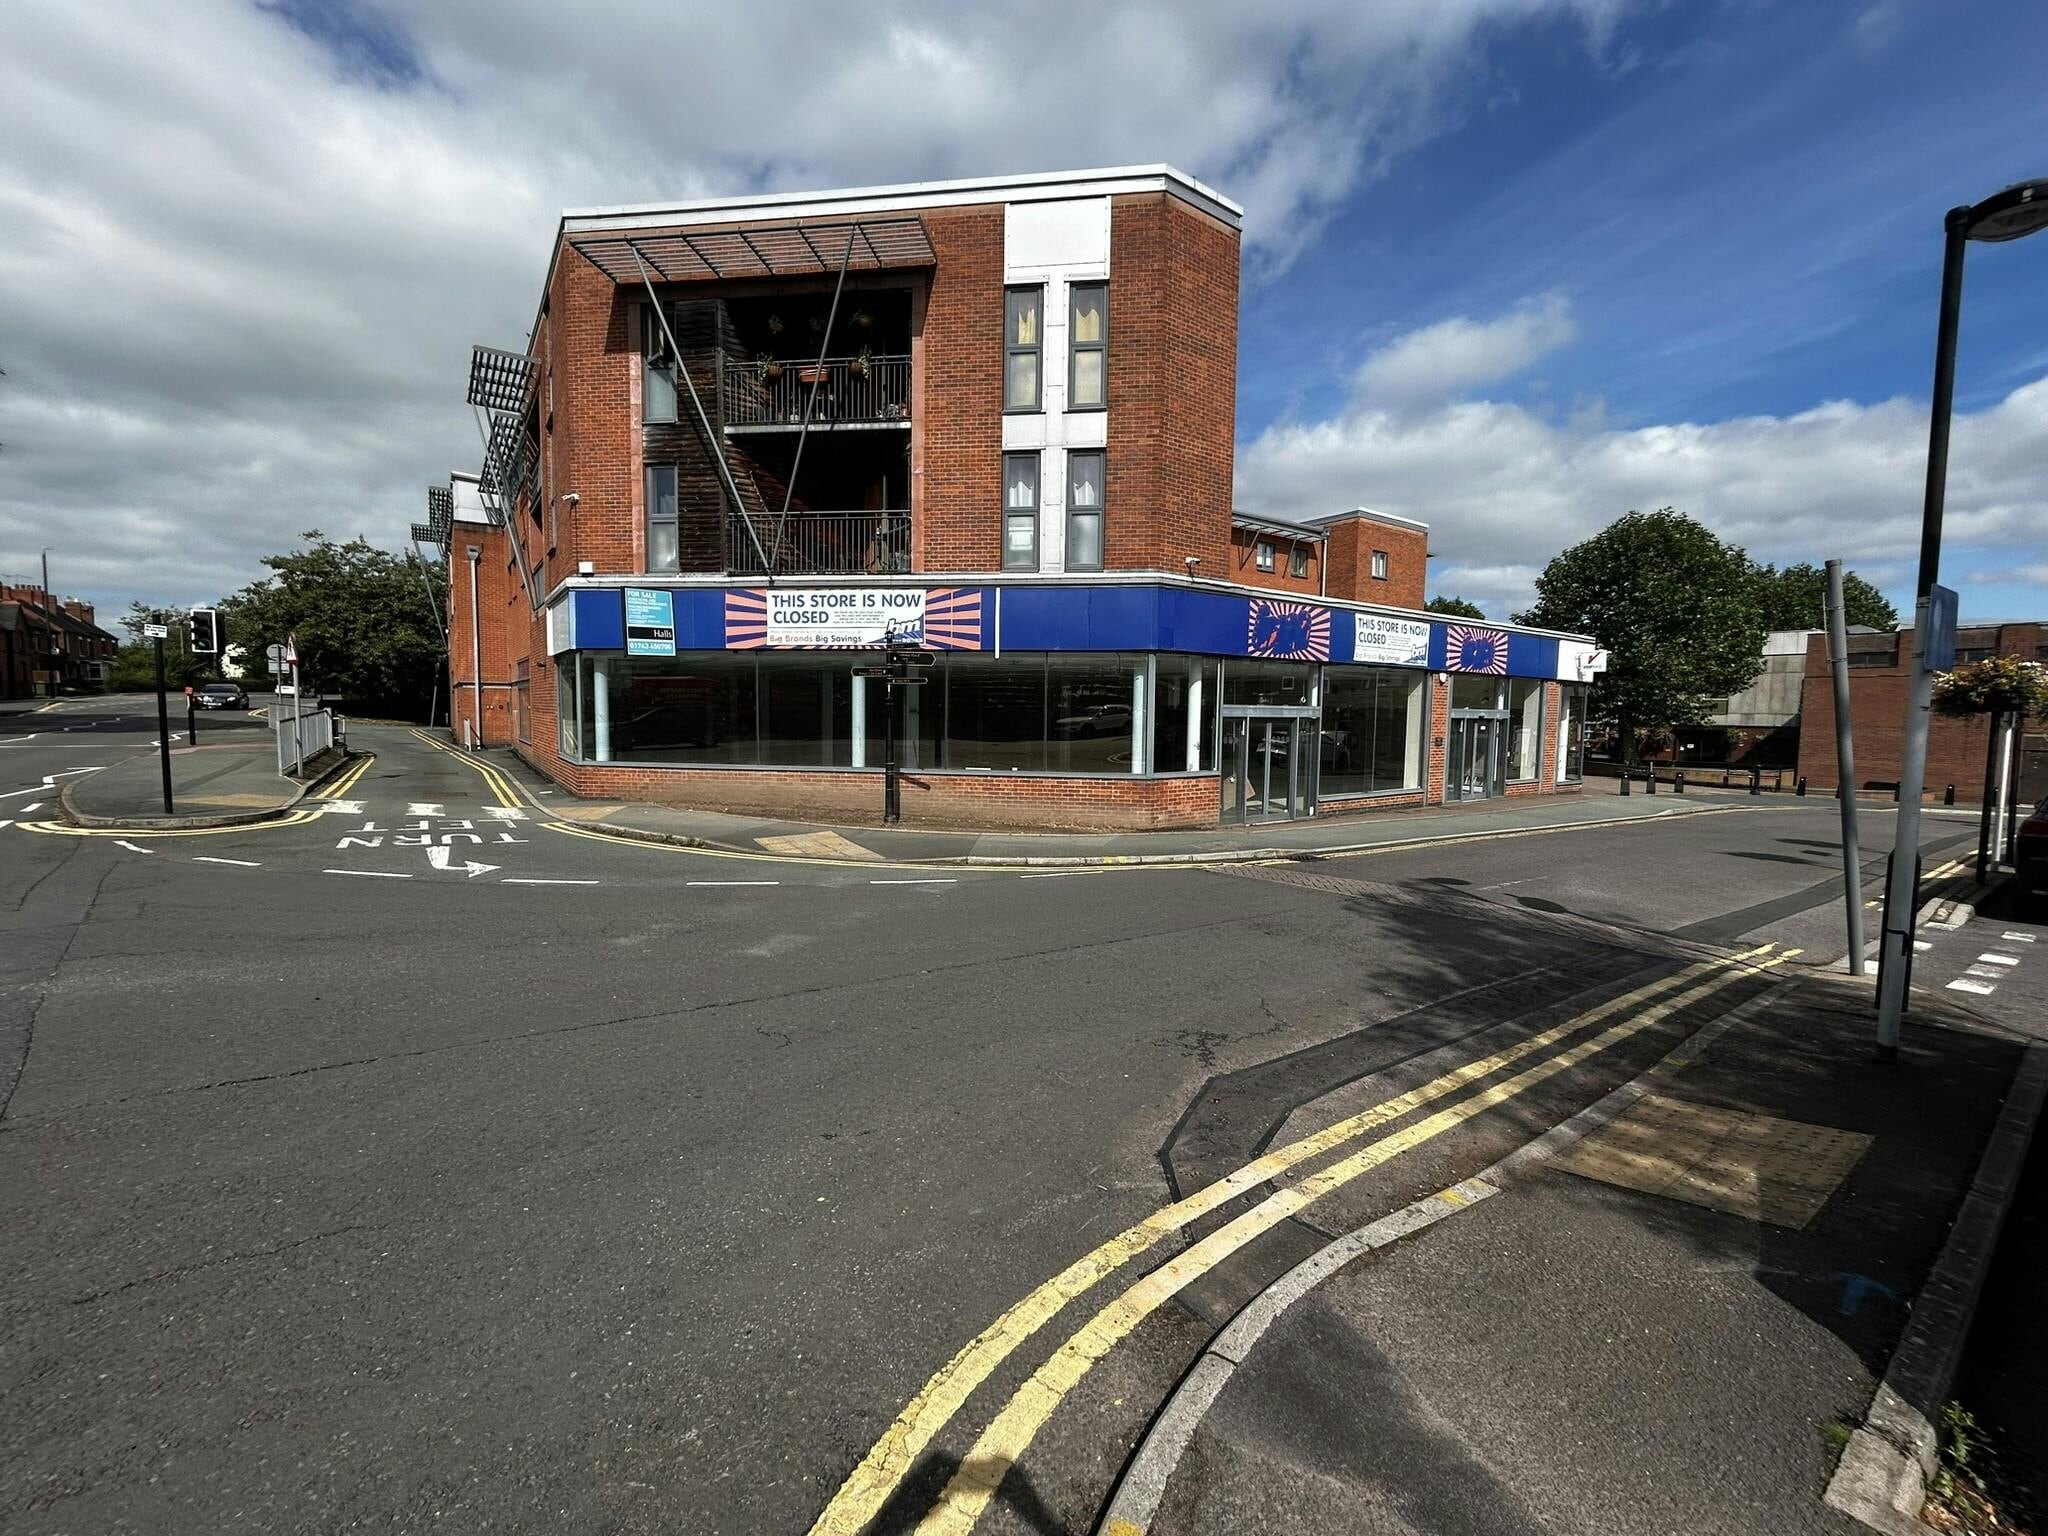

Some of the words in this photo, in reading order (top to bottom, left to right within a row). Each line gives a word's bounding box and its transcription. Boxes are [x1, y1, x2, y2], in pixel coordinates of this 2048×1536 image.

[771, 594, 805, 608] THIS
[810, 594, 857, 608] STORE
[862, 594, 876, 608] IS
[881, 594, 921, 608] NOW
[773, 610, 829, 624] CLOSED
[1358, 617, 1375, 630] THIS
[1377, 620, 1399, 633] STORE
[1401, 623, 1408, 634] IS
[1409, 625, 1427, 636] NOW
[653, 630, 672, 638] Halls
[769, 634, 783, 644] Big
[785, 634, 813, 643] Brands
[815, 634, 829, 644] Big
[831, 634, 862, 644] Savings
[1358, 631, 1386, 644] CLOSED
[344, 819, 517, 832] LEFT
[335, 832, 530, 849] TURN
